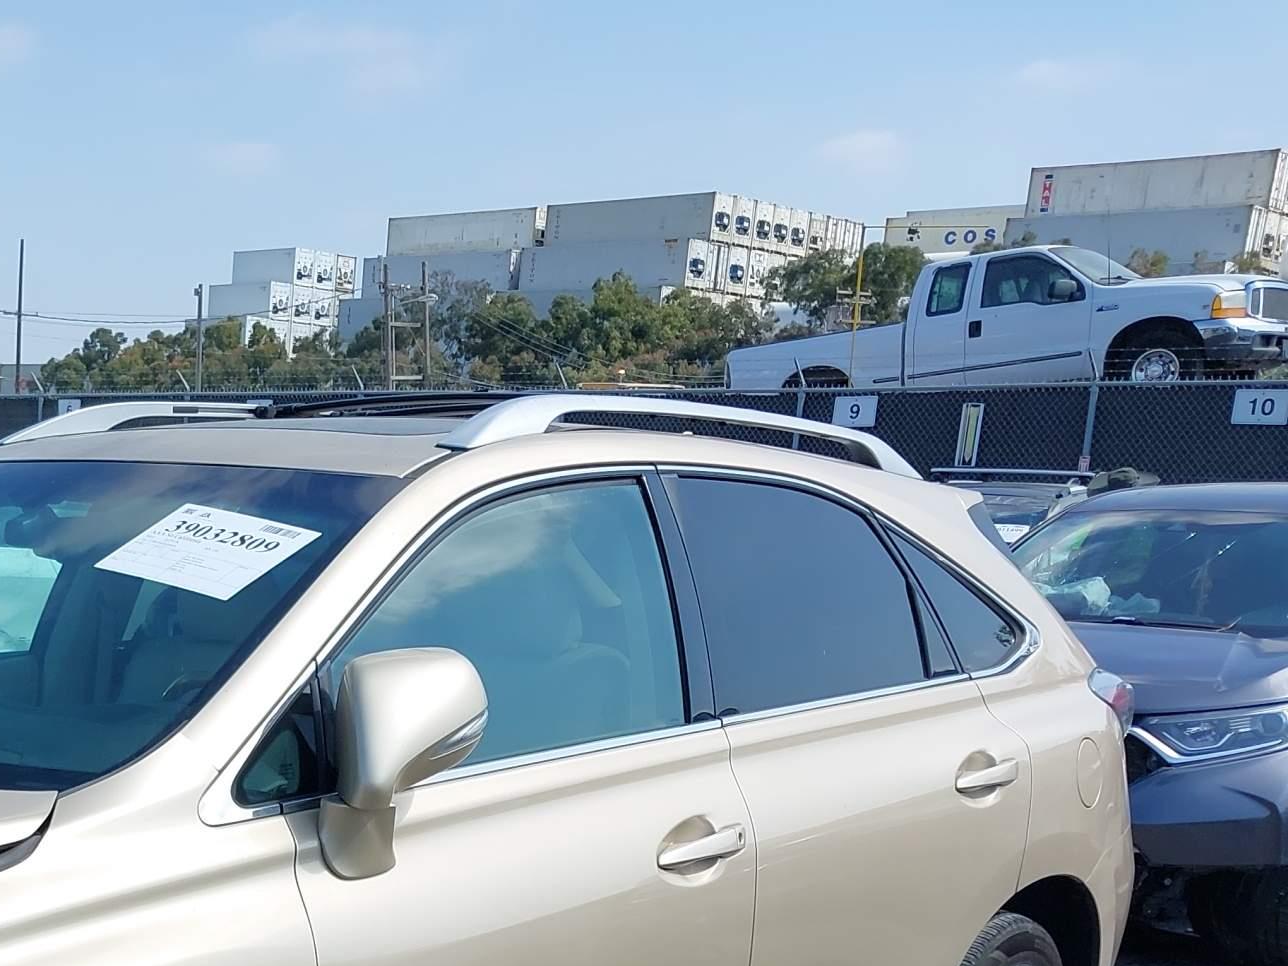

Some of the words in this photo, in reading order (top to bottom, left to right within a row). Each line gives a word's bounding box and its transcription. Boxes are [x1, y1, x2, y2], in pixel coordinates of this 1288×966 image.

[848, 403, 861, 420] 9
[1248, 398, 1276, 417] 10
[164, 520, 281, 553] 39032809
